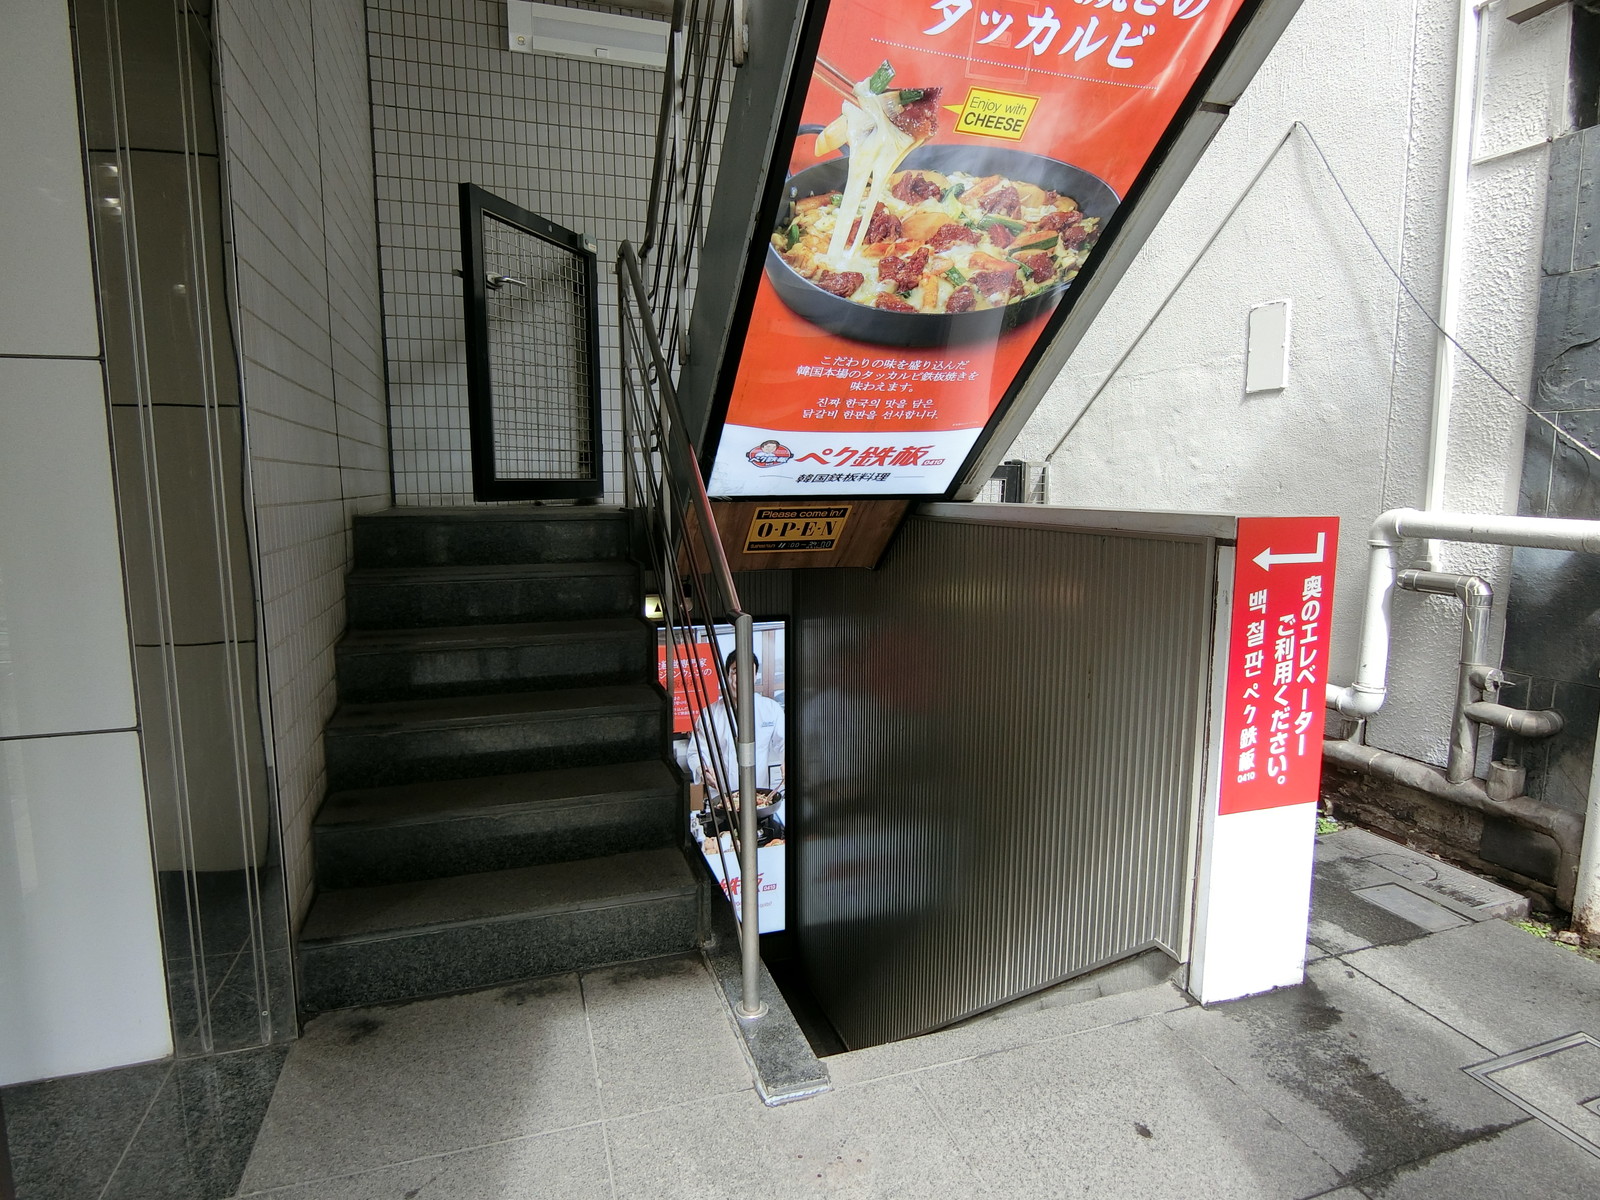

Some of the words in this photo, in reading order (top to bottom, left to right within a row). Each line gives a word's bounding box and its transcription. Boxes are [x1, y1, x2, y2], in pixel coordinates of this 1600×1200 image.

[970, 96, 1002, 113] Enjoy
[1005, 103, 1027, 115] with
[964, 112, 1024, 132] CHEESE
[820, 355, 970, 371] こだわりの味を盛り込んだ
[850, 381, 914, 393] 味わえます。
[816, 397, 841, 408] 진짜
[845, 398, 881, 409] 한국의
[885, 399, 907, 409] 맛을
[912, 399, 934, 409] 담은
[802, 408, 838, 419] 닭갈비
[843, 410, 877, 420] 한판을
[882, 410, 939, 420] 선사합니다.
[795, 472, 891, 483] 韓国鉄板料理
[761, 510, 797, 519] Please
[799, 510, 828, 518] come
[829, 509, 844, 517] in!
[1294, 575, 1323, 756] 奥のエレベーター
[1267, 614, 1296, 785] ご利用ください。
[1237, 771, 1256, 783] 0410
